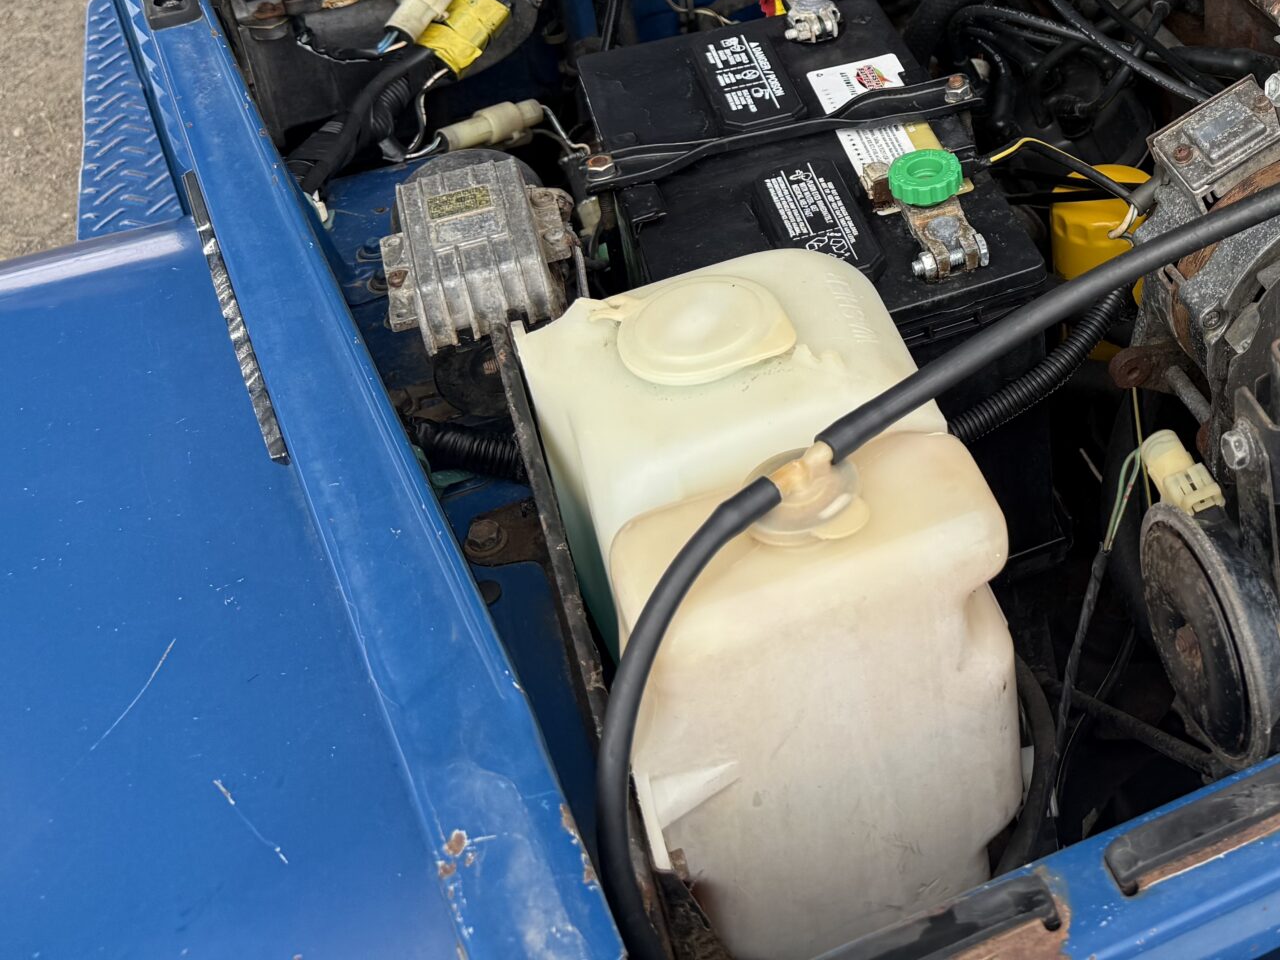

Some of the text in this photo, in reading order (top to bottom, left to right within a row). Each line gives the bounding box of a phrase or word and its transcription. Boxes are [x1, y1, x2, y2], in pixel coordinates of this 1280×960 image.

[752, 47, 772, 71] DANGER
[766, 74, 785, 96] POISON
[864, 64, 885, 89] INTERSTAT
